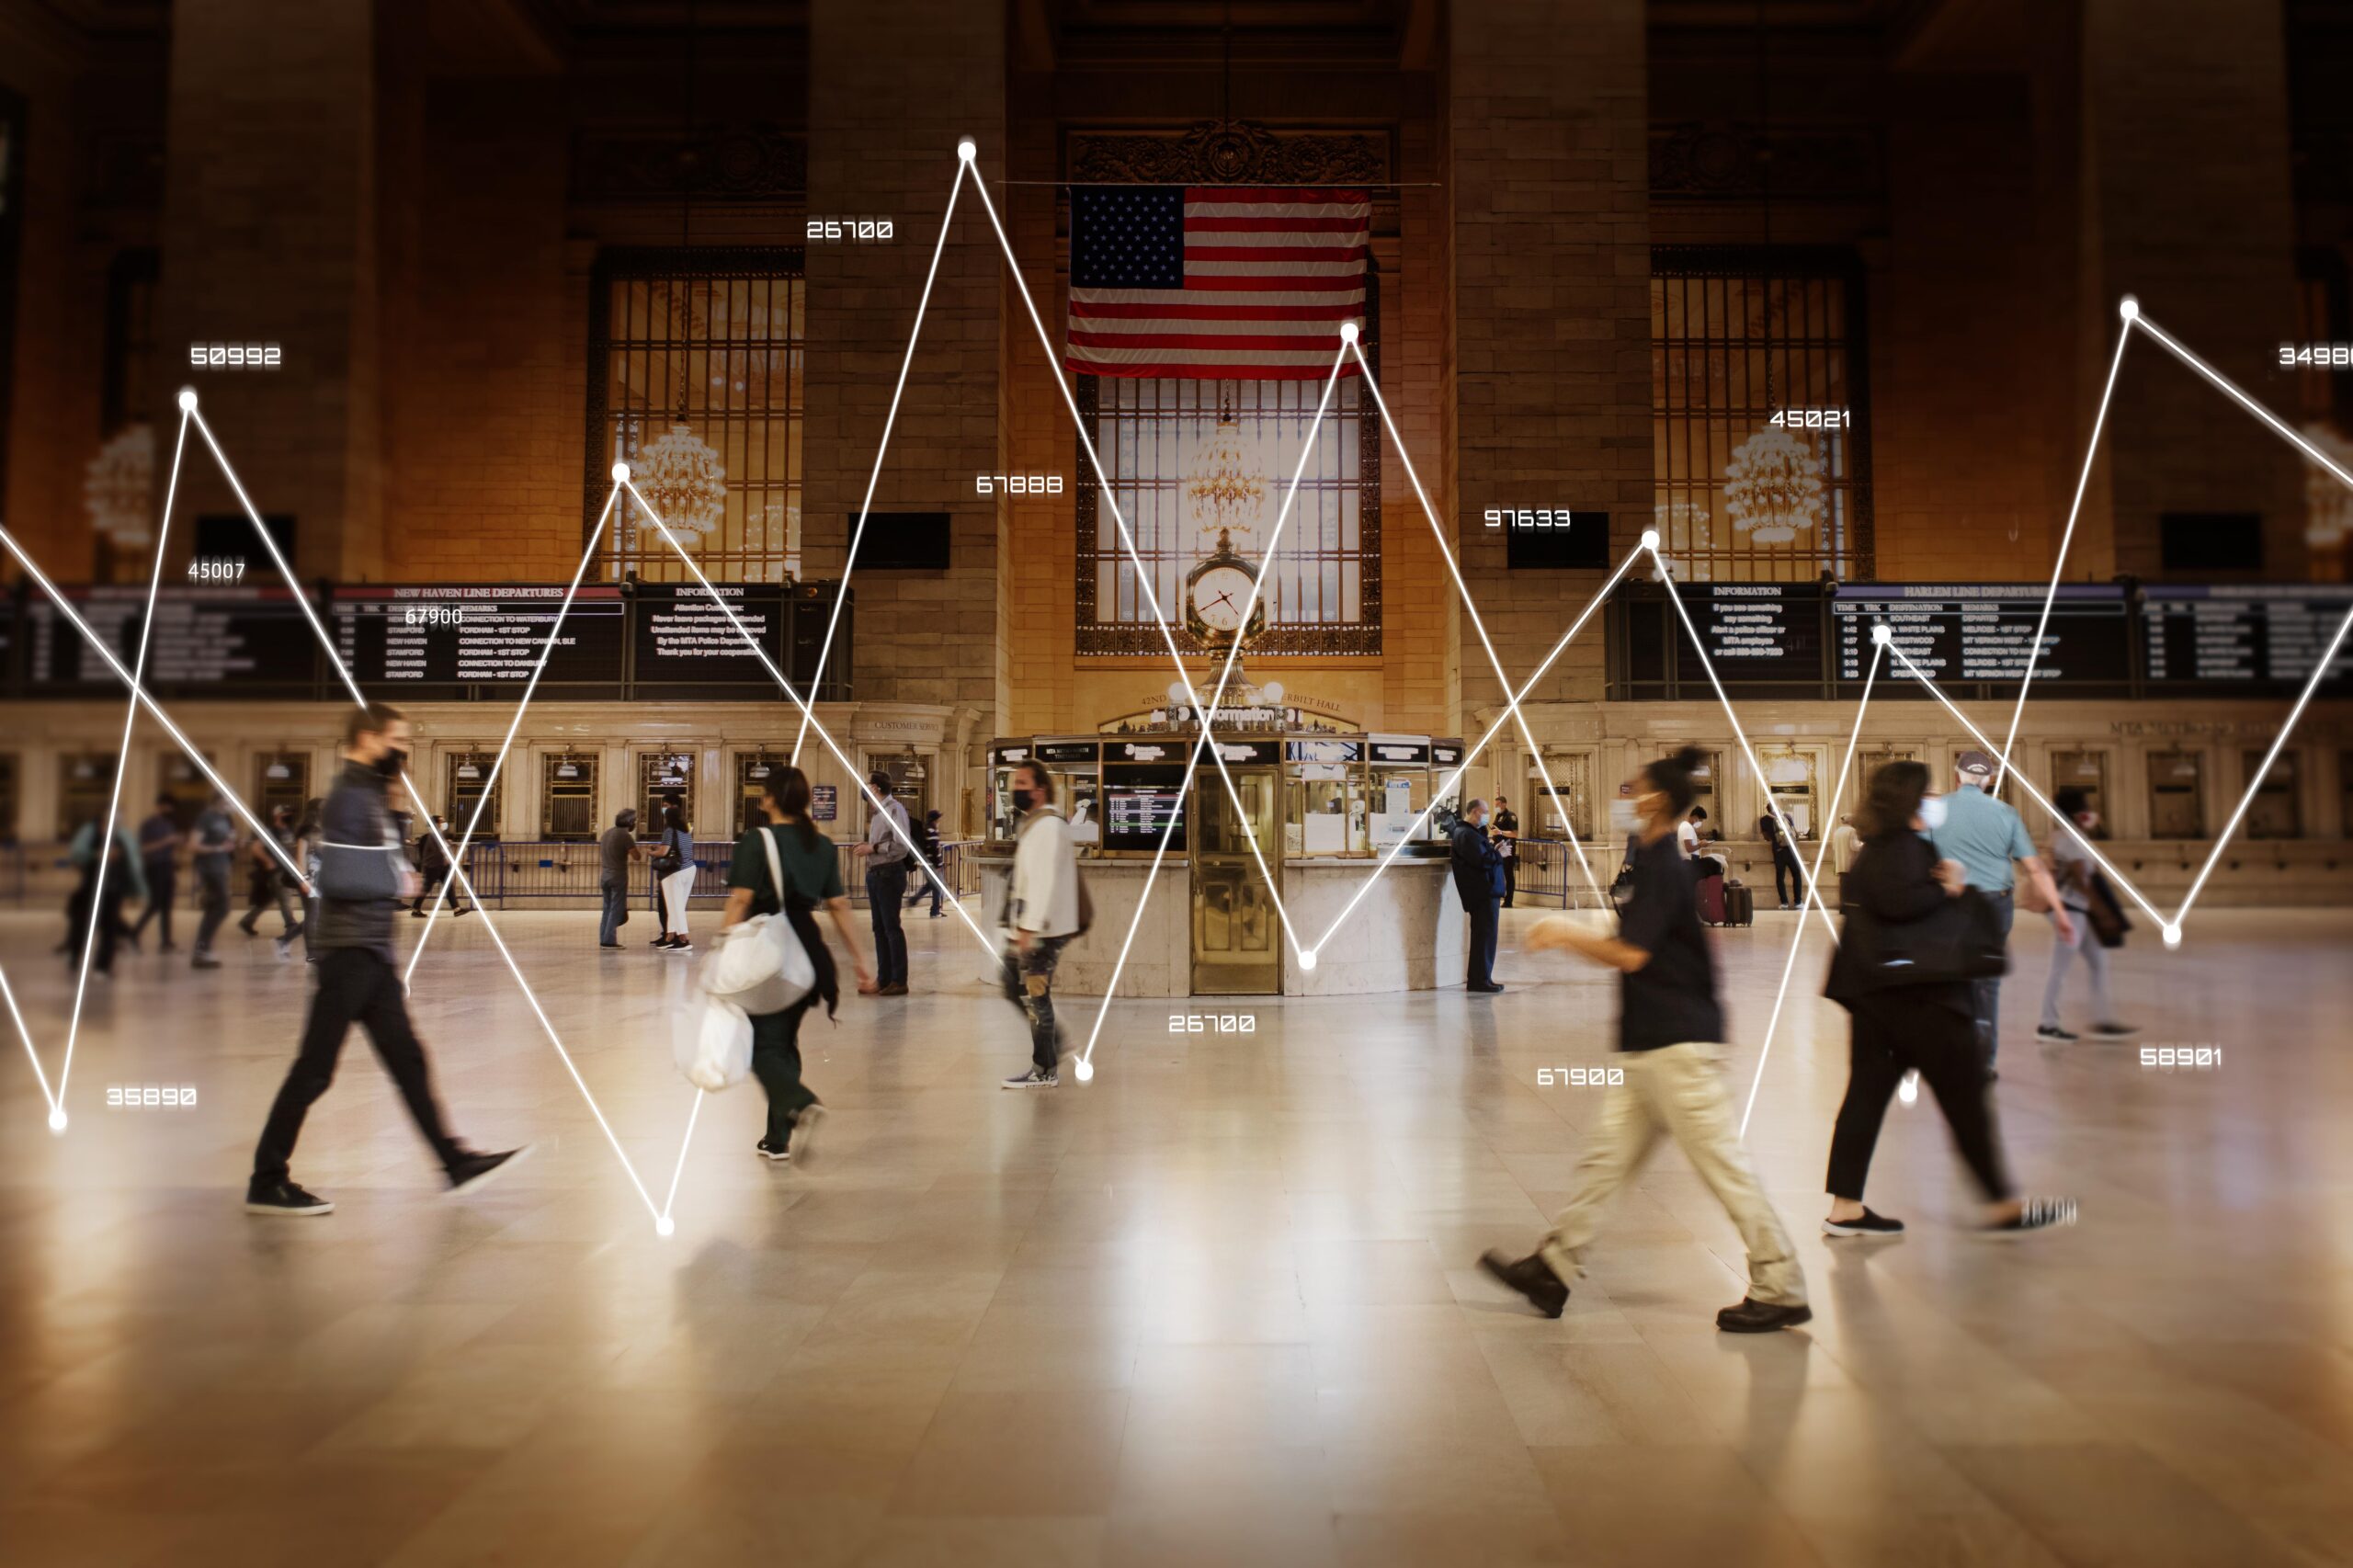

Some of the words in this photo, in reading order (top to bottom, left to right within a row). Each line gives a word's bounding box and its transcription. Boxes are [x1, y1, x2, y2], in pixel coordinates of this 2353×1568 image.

[393, 588, 420, 598] NEW
[422, 588, 462, 598] HAVEN
[463, 588, 491, 598] LINE
[492, 588, 563, 598] DEPARTURES
[676, 587, 744, 597] INFORATION
[1713, 586, 1782, 597] INFORMATION
[1889, 604, 1943, 612] DESTINATION
[1141, 694, 1168, 706] 42ND
